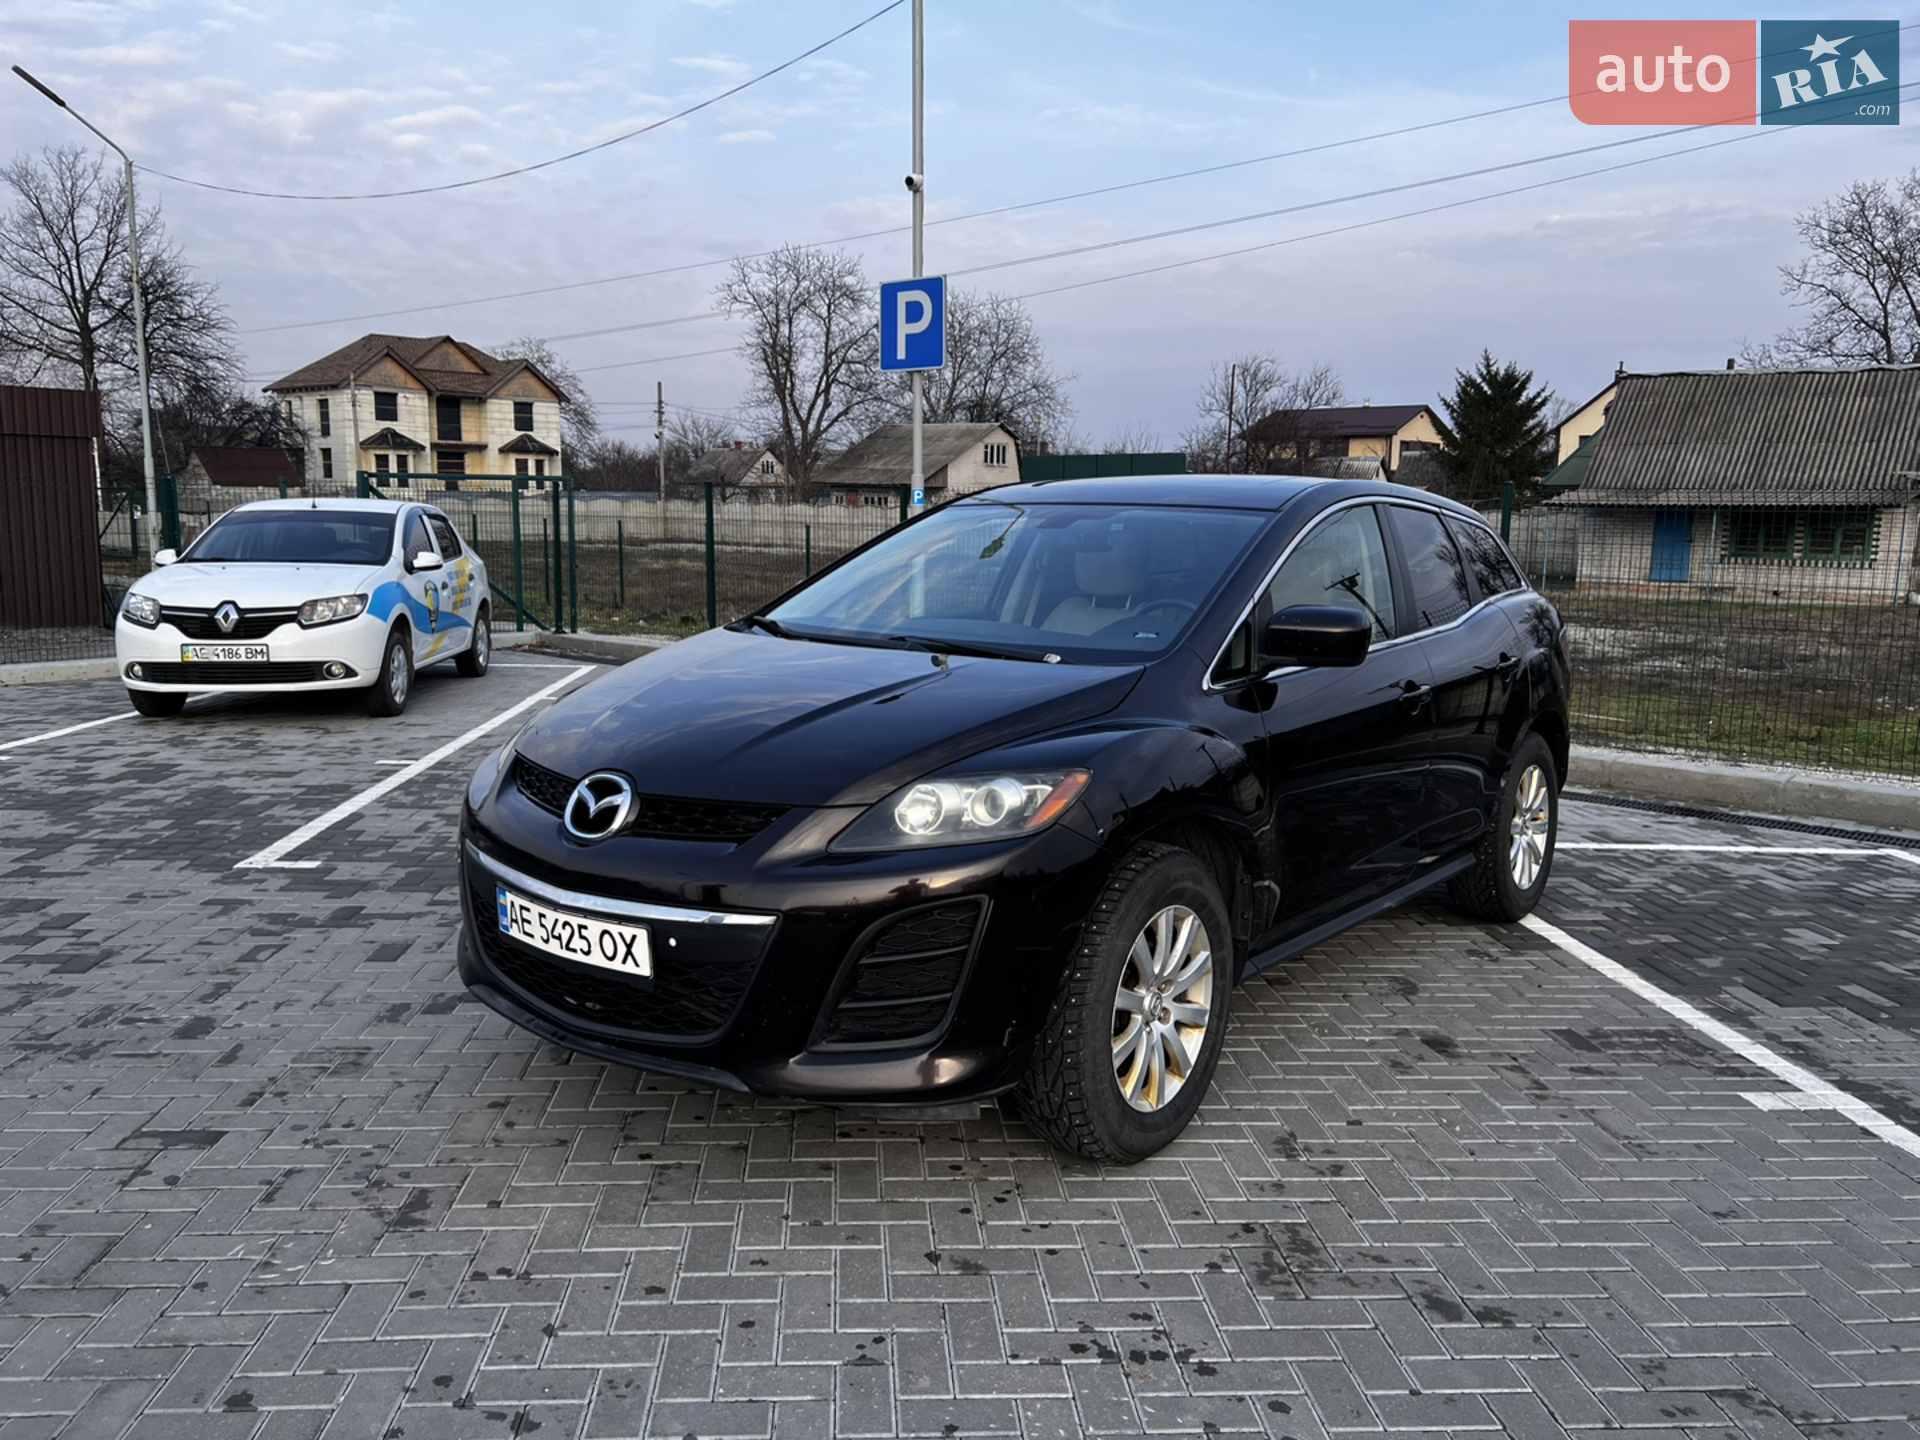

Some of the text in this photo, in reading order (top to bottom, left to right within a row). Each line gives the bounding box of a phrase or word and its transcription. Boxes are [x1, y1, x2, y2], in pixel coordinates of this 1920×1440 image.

[897, 289, 933, 360] P
[914, 489, 923, 503] P
[213, 647, 242, 660] 4186
[245, 647, 265, 660] BM
[510, 900, 640, 968] AE 5425 OX
